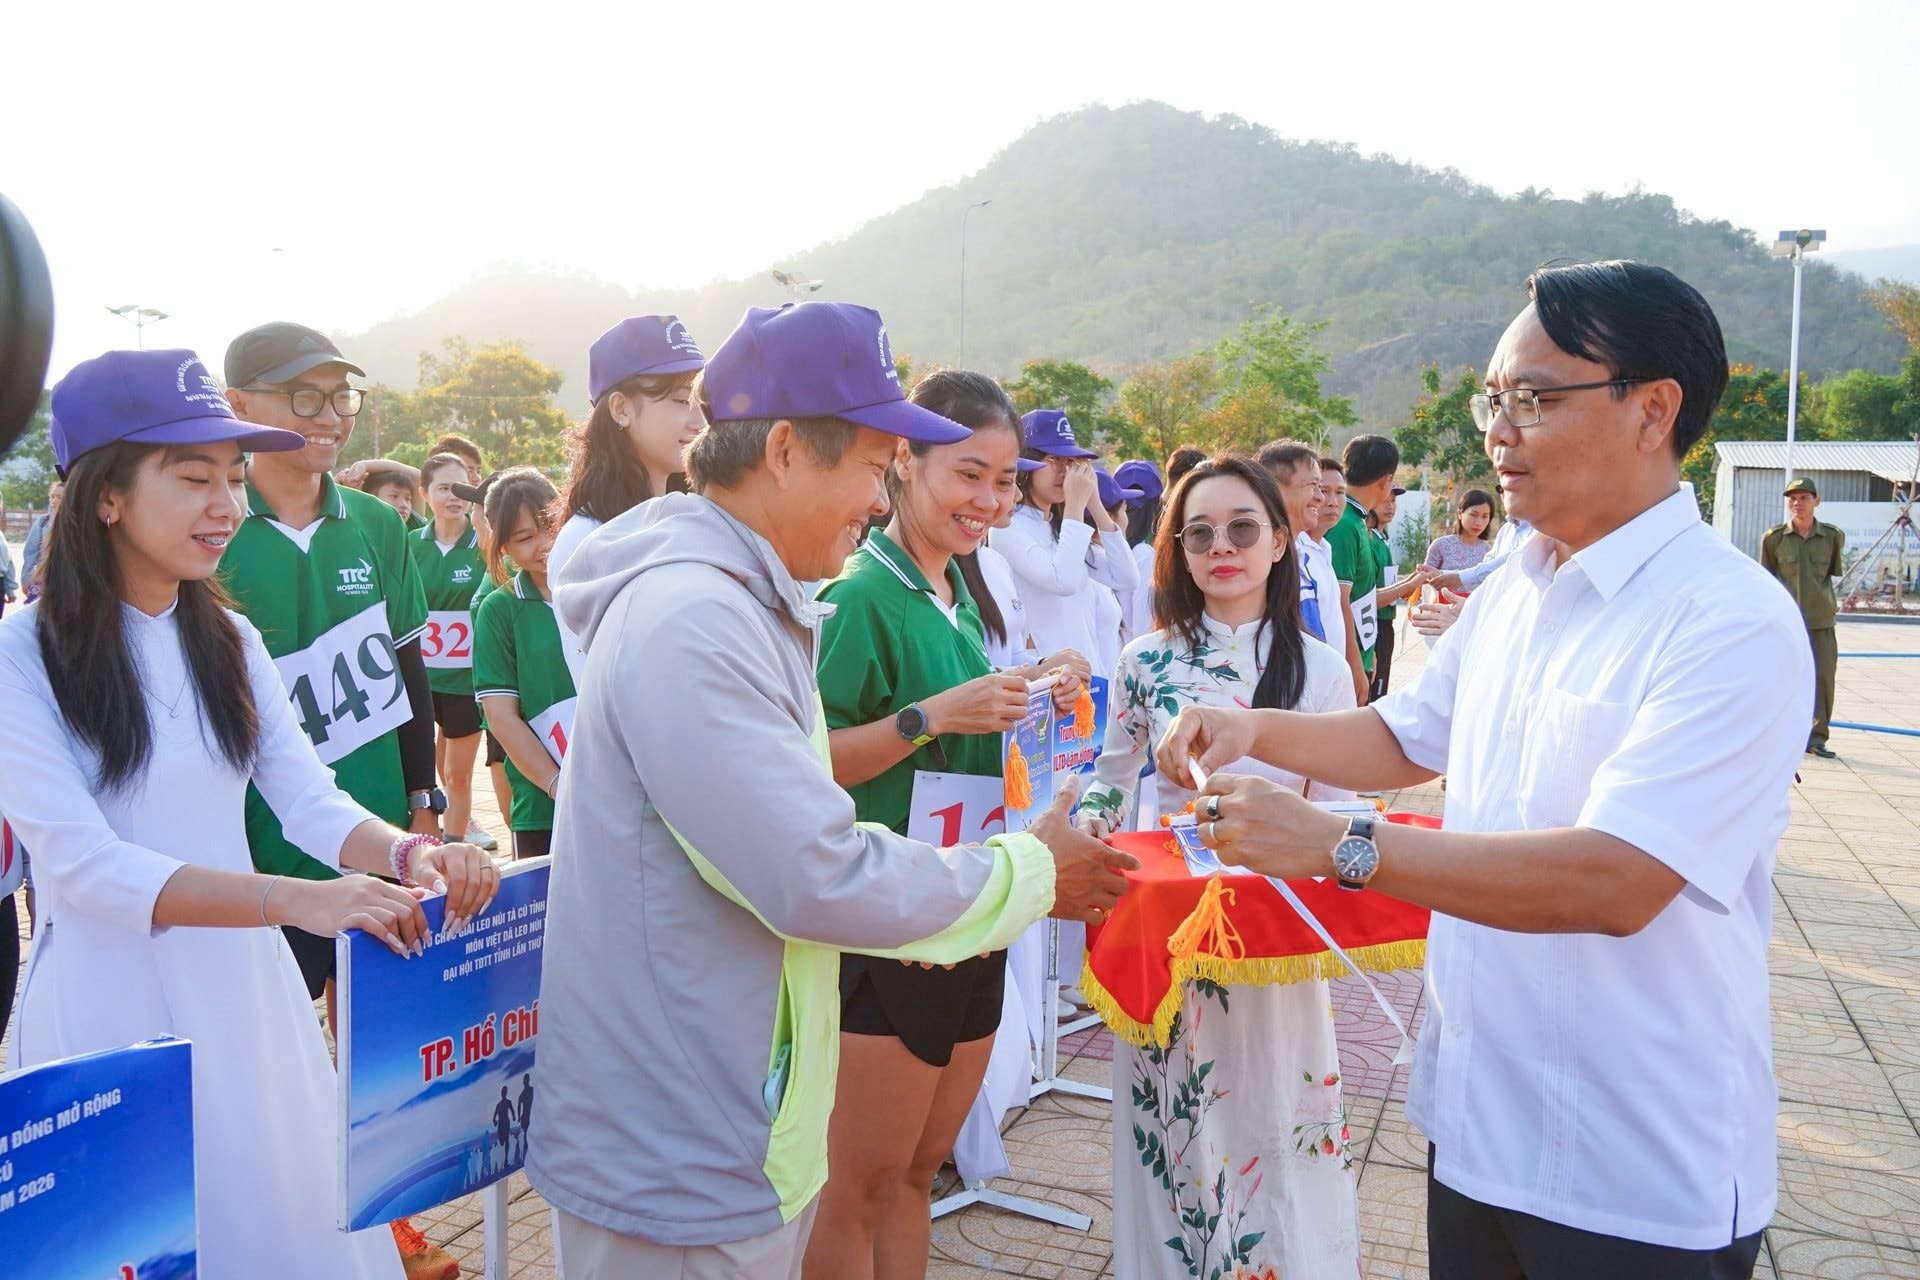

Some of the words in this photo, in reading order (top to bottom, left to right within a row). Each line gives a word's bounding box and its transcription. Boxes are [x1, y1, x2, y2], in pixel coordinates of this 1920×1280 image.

[336, 583, 374, 592] HOSPITALITY
[339, 568, 369, 583] TTC
[289, 632, 405, 747] 449
[929, 801, 1007, 848] 1
[434, 930, 457, 946] CH
[476, 917, 491, 932] LEO
[492, 910, 506, 926] NÚI
[507, 907, 517, 922] TÀ
[517, 903, 528, 919] CÚ
[465, 937, 484, 955] MÔN
[485, 932, 502, 948] VIỆT
[514, 923, 528, 938] LEO
[529, 918, 542, 934] NÚI
[443, 966, 458, 982] ĐẠI
[459, 961, 473, 977] HỘI
[475, 954, 492, 970] TDTT
[494, 947, 511, 964] TỈNH
[420, 1037, 456, 1082] TP.
[464, 1014, 496, 1065] Hồ
[502, 1000, 539, 1048] Chí
[57, 1100, 81, 1130] MỞ
[83, 1088, 122, 1118] RỘNG
[19, 1172, 55, 1204] 2026
